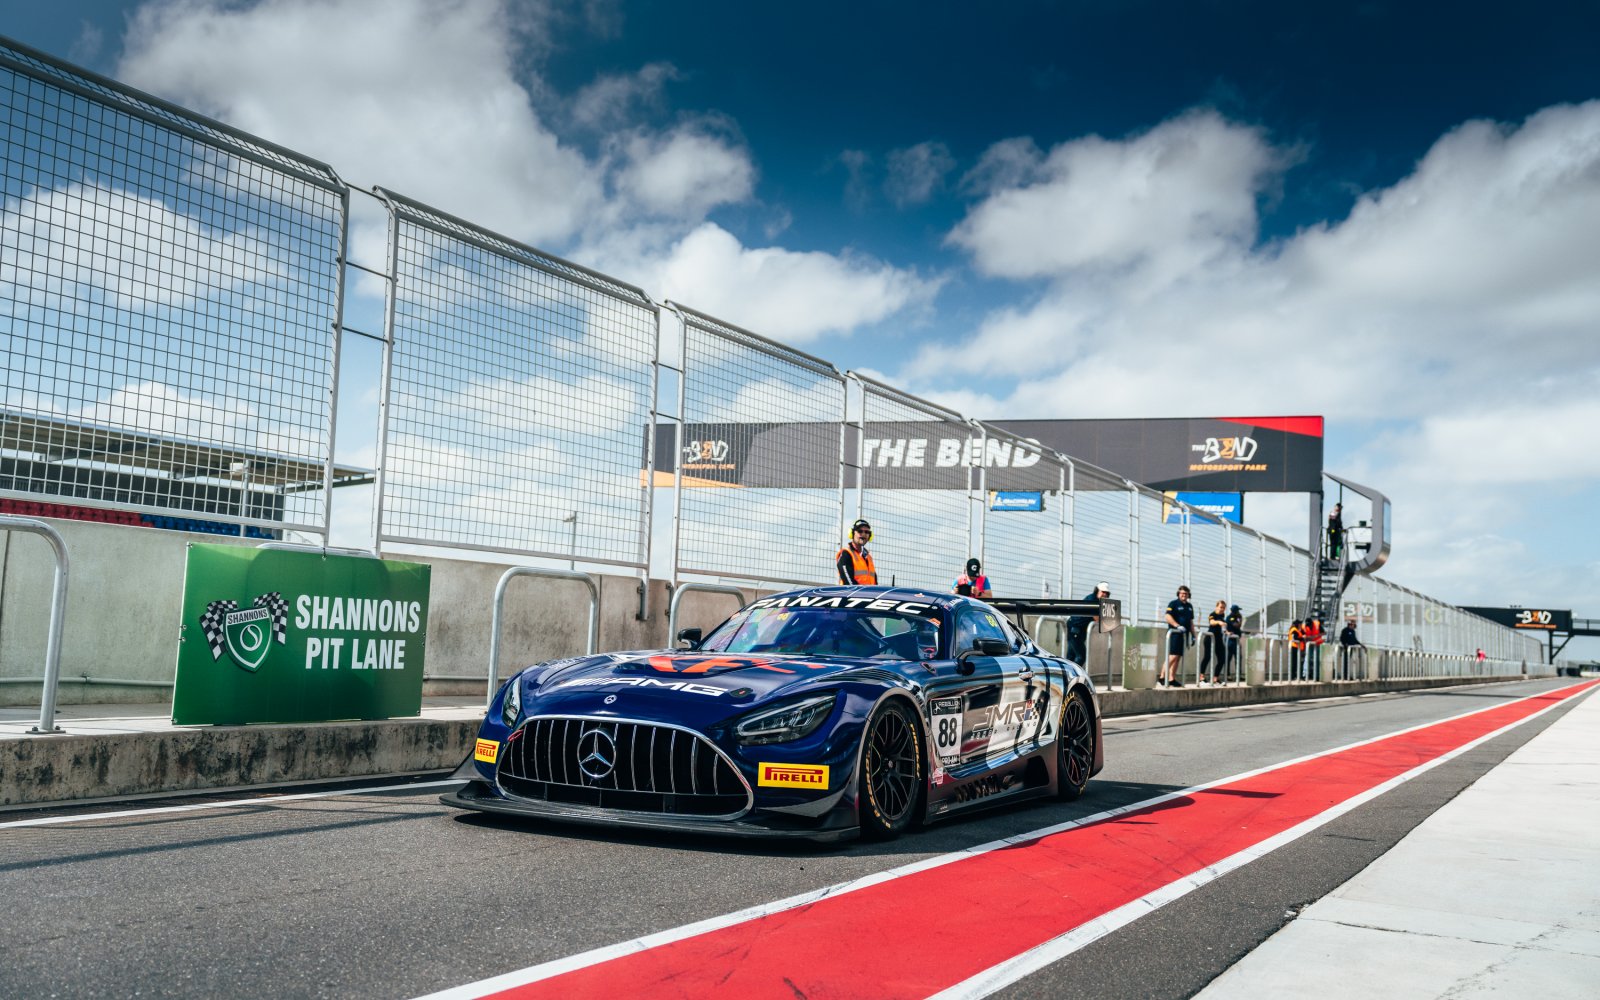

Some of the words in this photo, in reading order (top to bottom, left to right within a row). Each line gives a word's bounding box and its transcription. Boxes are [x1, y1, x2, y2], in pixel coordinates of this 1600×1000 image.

[863, 439, 928, 467] THE
[936, 438, 1042, 467] BEND
[1201, 437, 1257, 463] BEND
[227, 608, 268, 625] SHANNONS
[295, 594, 421, 633] SHANNONS
[748, 597, 930, 614] FANATEC
[305, 637, 345, 669] PIT
[351, 638, 406, 669] LANE
[606, 677, 728, 696] AMG
[938, 717, 958, 748] 88
[764, 767, 824, 783] PIRELLI
